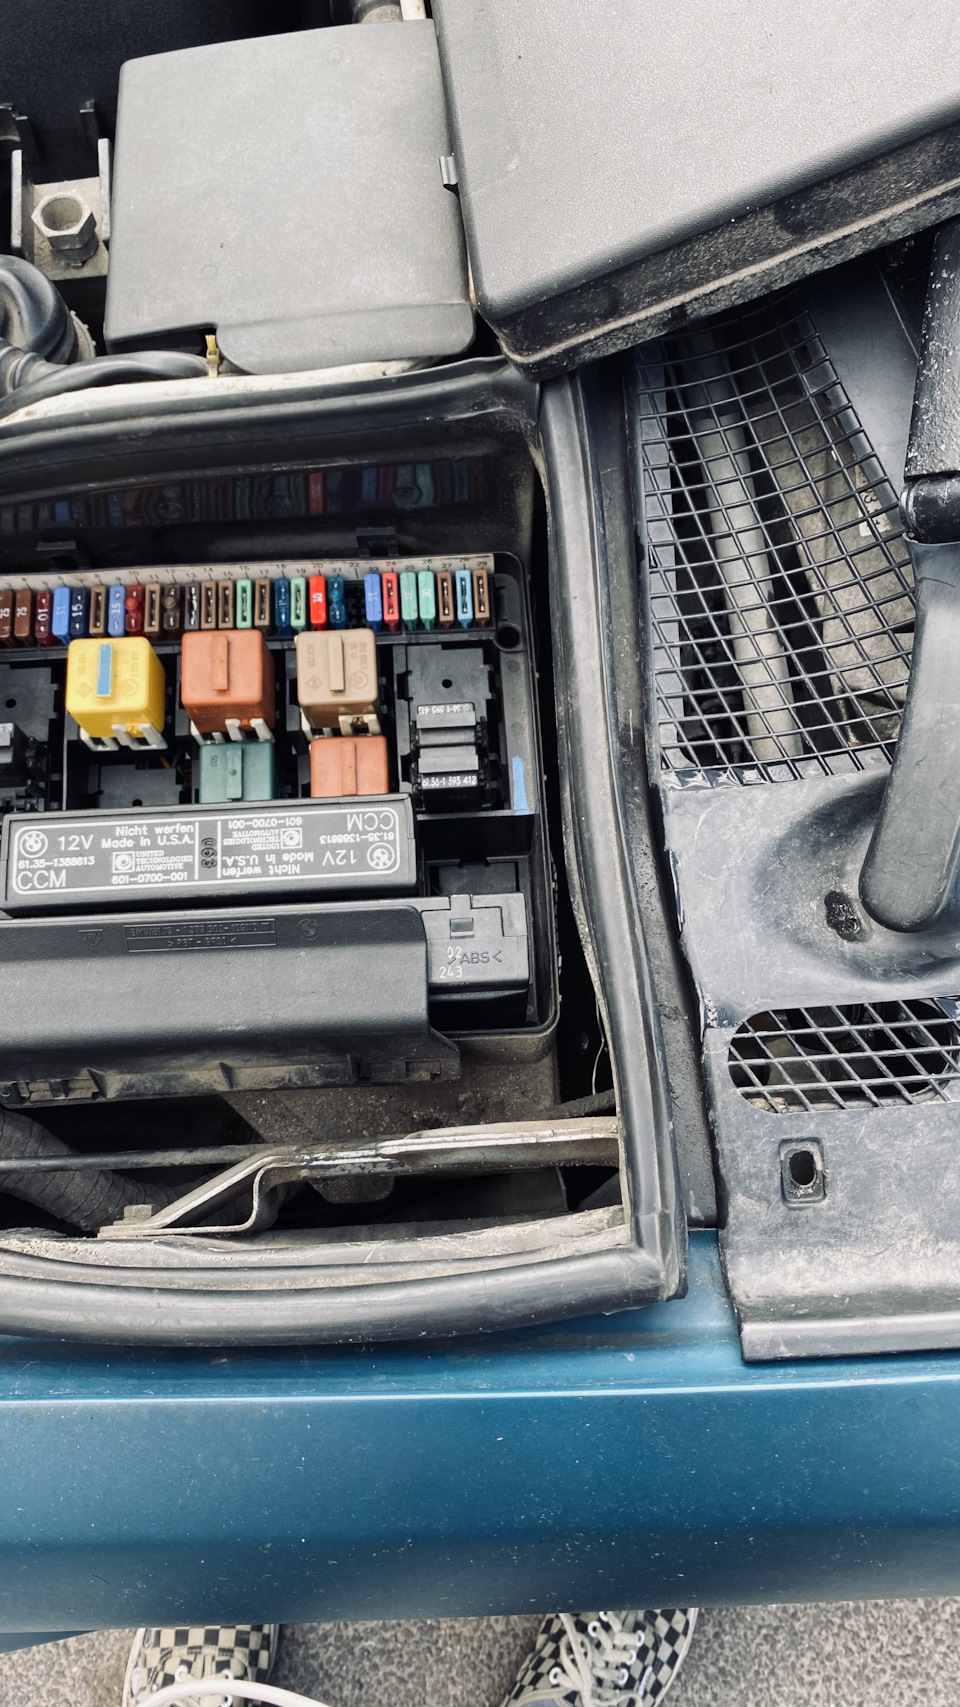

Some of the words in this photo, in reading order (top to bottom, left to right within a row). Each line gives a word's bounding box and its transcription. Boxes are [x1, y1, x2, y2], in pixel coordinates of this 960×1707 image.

[71, 603, 83, 617] 15
[111, 602, 122, 614] 15
[37, 608, 49, 621] 10
[463, 775, 478, 785] 412
[228, 816, 303, 829] 601-0700-001
[347, 812, 395, 832] CCM
[115, 825, 148, 837] Nicht
[155, 823, 194, 835] werfen
[232, 829, 280, 838] AUTOMOTIVE
[58, 834, 94, 851] 12V
[101, 837, 134, 849] Made
[140, 836, 151, 847] in
[158, 834, 194, 846] U.S.A.
[223, 836, 280, 846] TECHNOLOGIES
[251, 842, 280, 851] UNITED
[136, 850, 165, 858] UNITED
[136, 855, 193, 864] TECHNOLOGIES
[266, 853, 276, 864] in
[282, 851, 314, 863] Made
[322, 849, 357, 867] 12V
[136, 862, 184, 872] AUTOMOTIVE
[222, 855, 258, 867] U.S.A.
[222, 865, 262, 877] werfen
[268, 863, 301, 875] Nicht
[18, 869, 67, 890] CCM
[112, 871, 188, 884] 601-0700-001
[440, 965, 463, 979] 243
